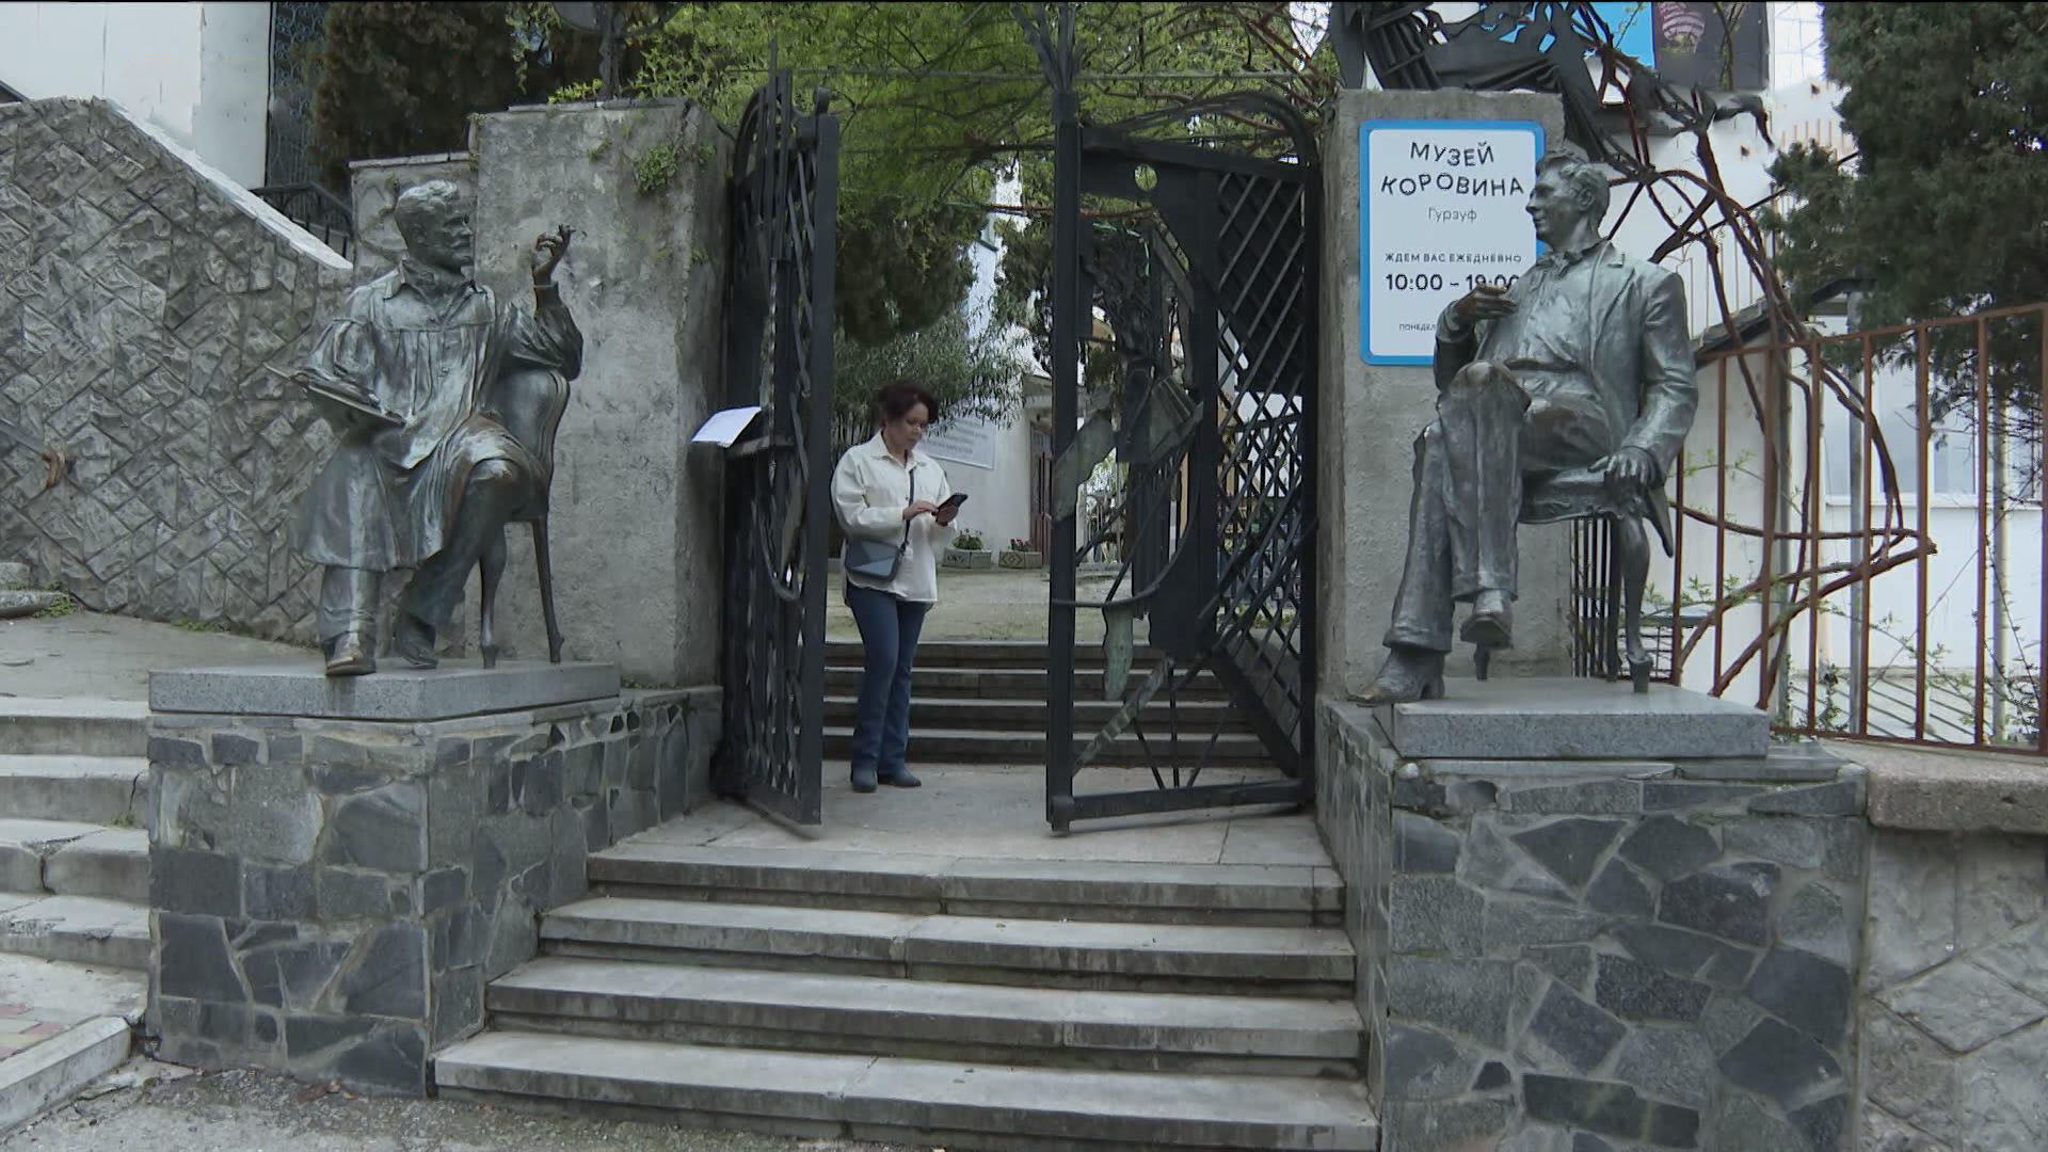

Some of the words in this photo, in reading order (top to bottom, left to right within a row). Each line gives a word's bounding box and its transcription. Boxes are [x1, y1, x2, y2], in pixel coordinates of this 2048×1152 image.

[1410, 141, 1494, 166] МУЗЕЙ
[1381, 172, 1524, 196] КОРОВИНА
[1428, 207, 1477, 222] Гурзуф
[1423, 253, 1445, 262] ВАС
[1449, 253, 1522, 264] ЕЖЕДНЕВНО
[1385, 274, 1443, 291] 10:00
